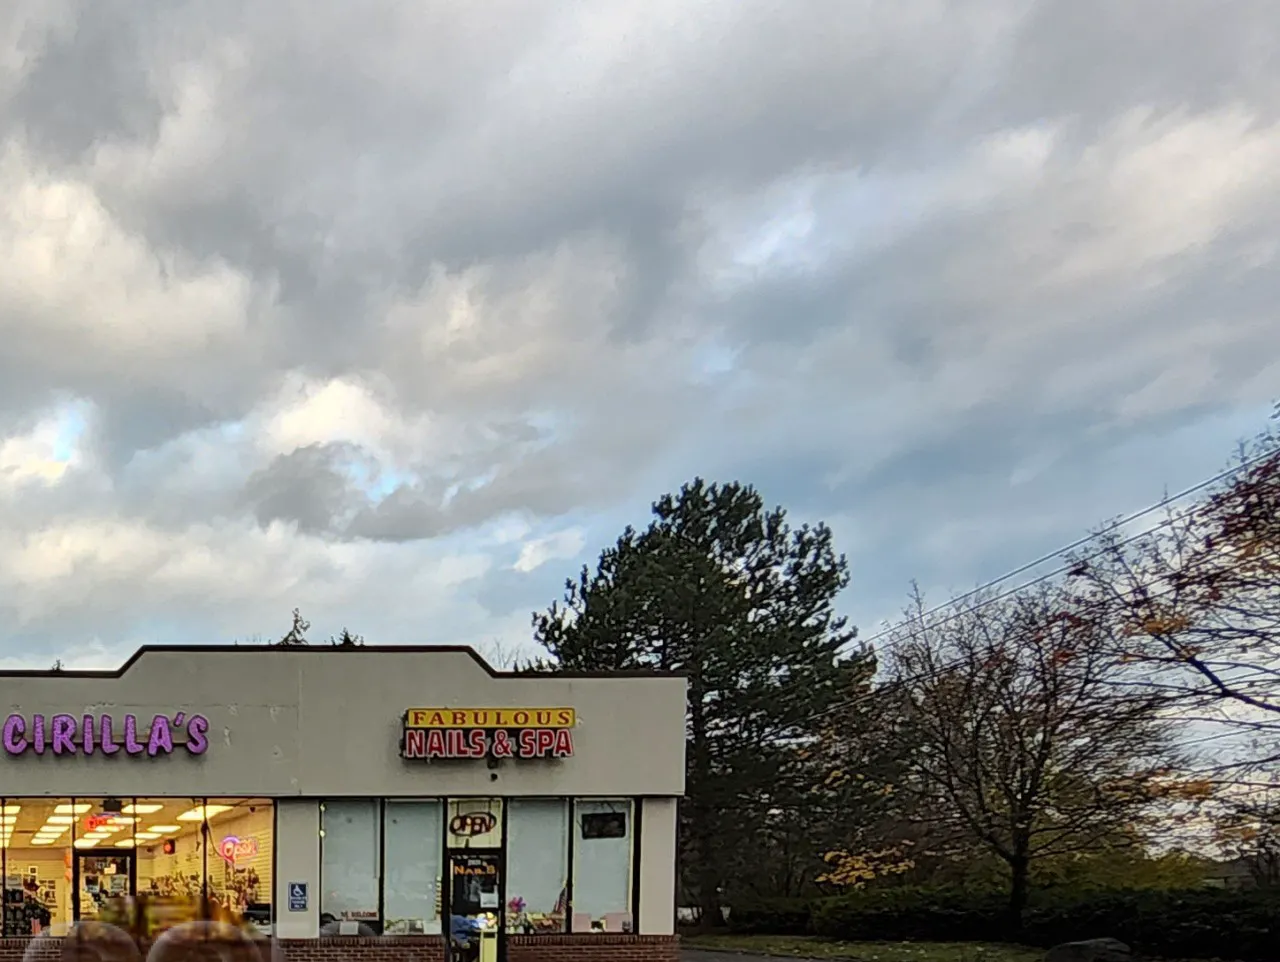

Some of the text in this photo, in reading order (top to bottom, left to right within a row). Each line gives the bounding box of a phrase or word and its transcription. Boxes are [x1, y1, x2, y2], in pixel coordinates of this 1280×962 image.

[413, 711, 571, 725] FABULOUS
[2, 711, 209, 755] CIRILLA'S
[407, 729, 574, 757] NAILS & SPA
[452, 815, 491, 833] OPEN
